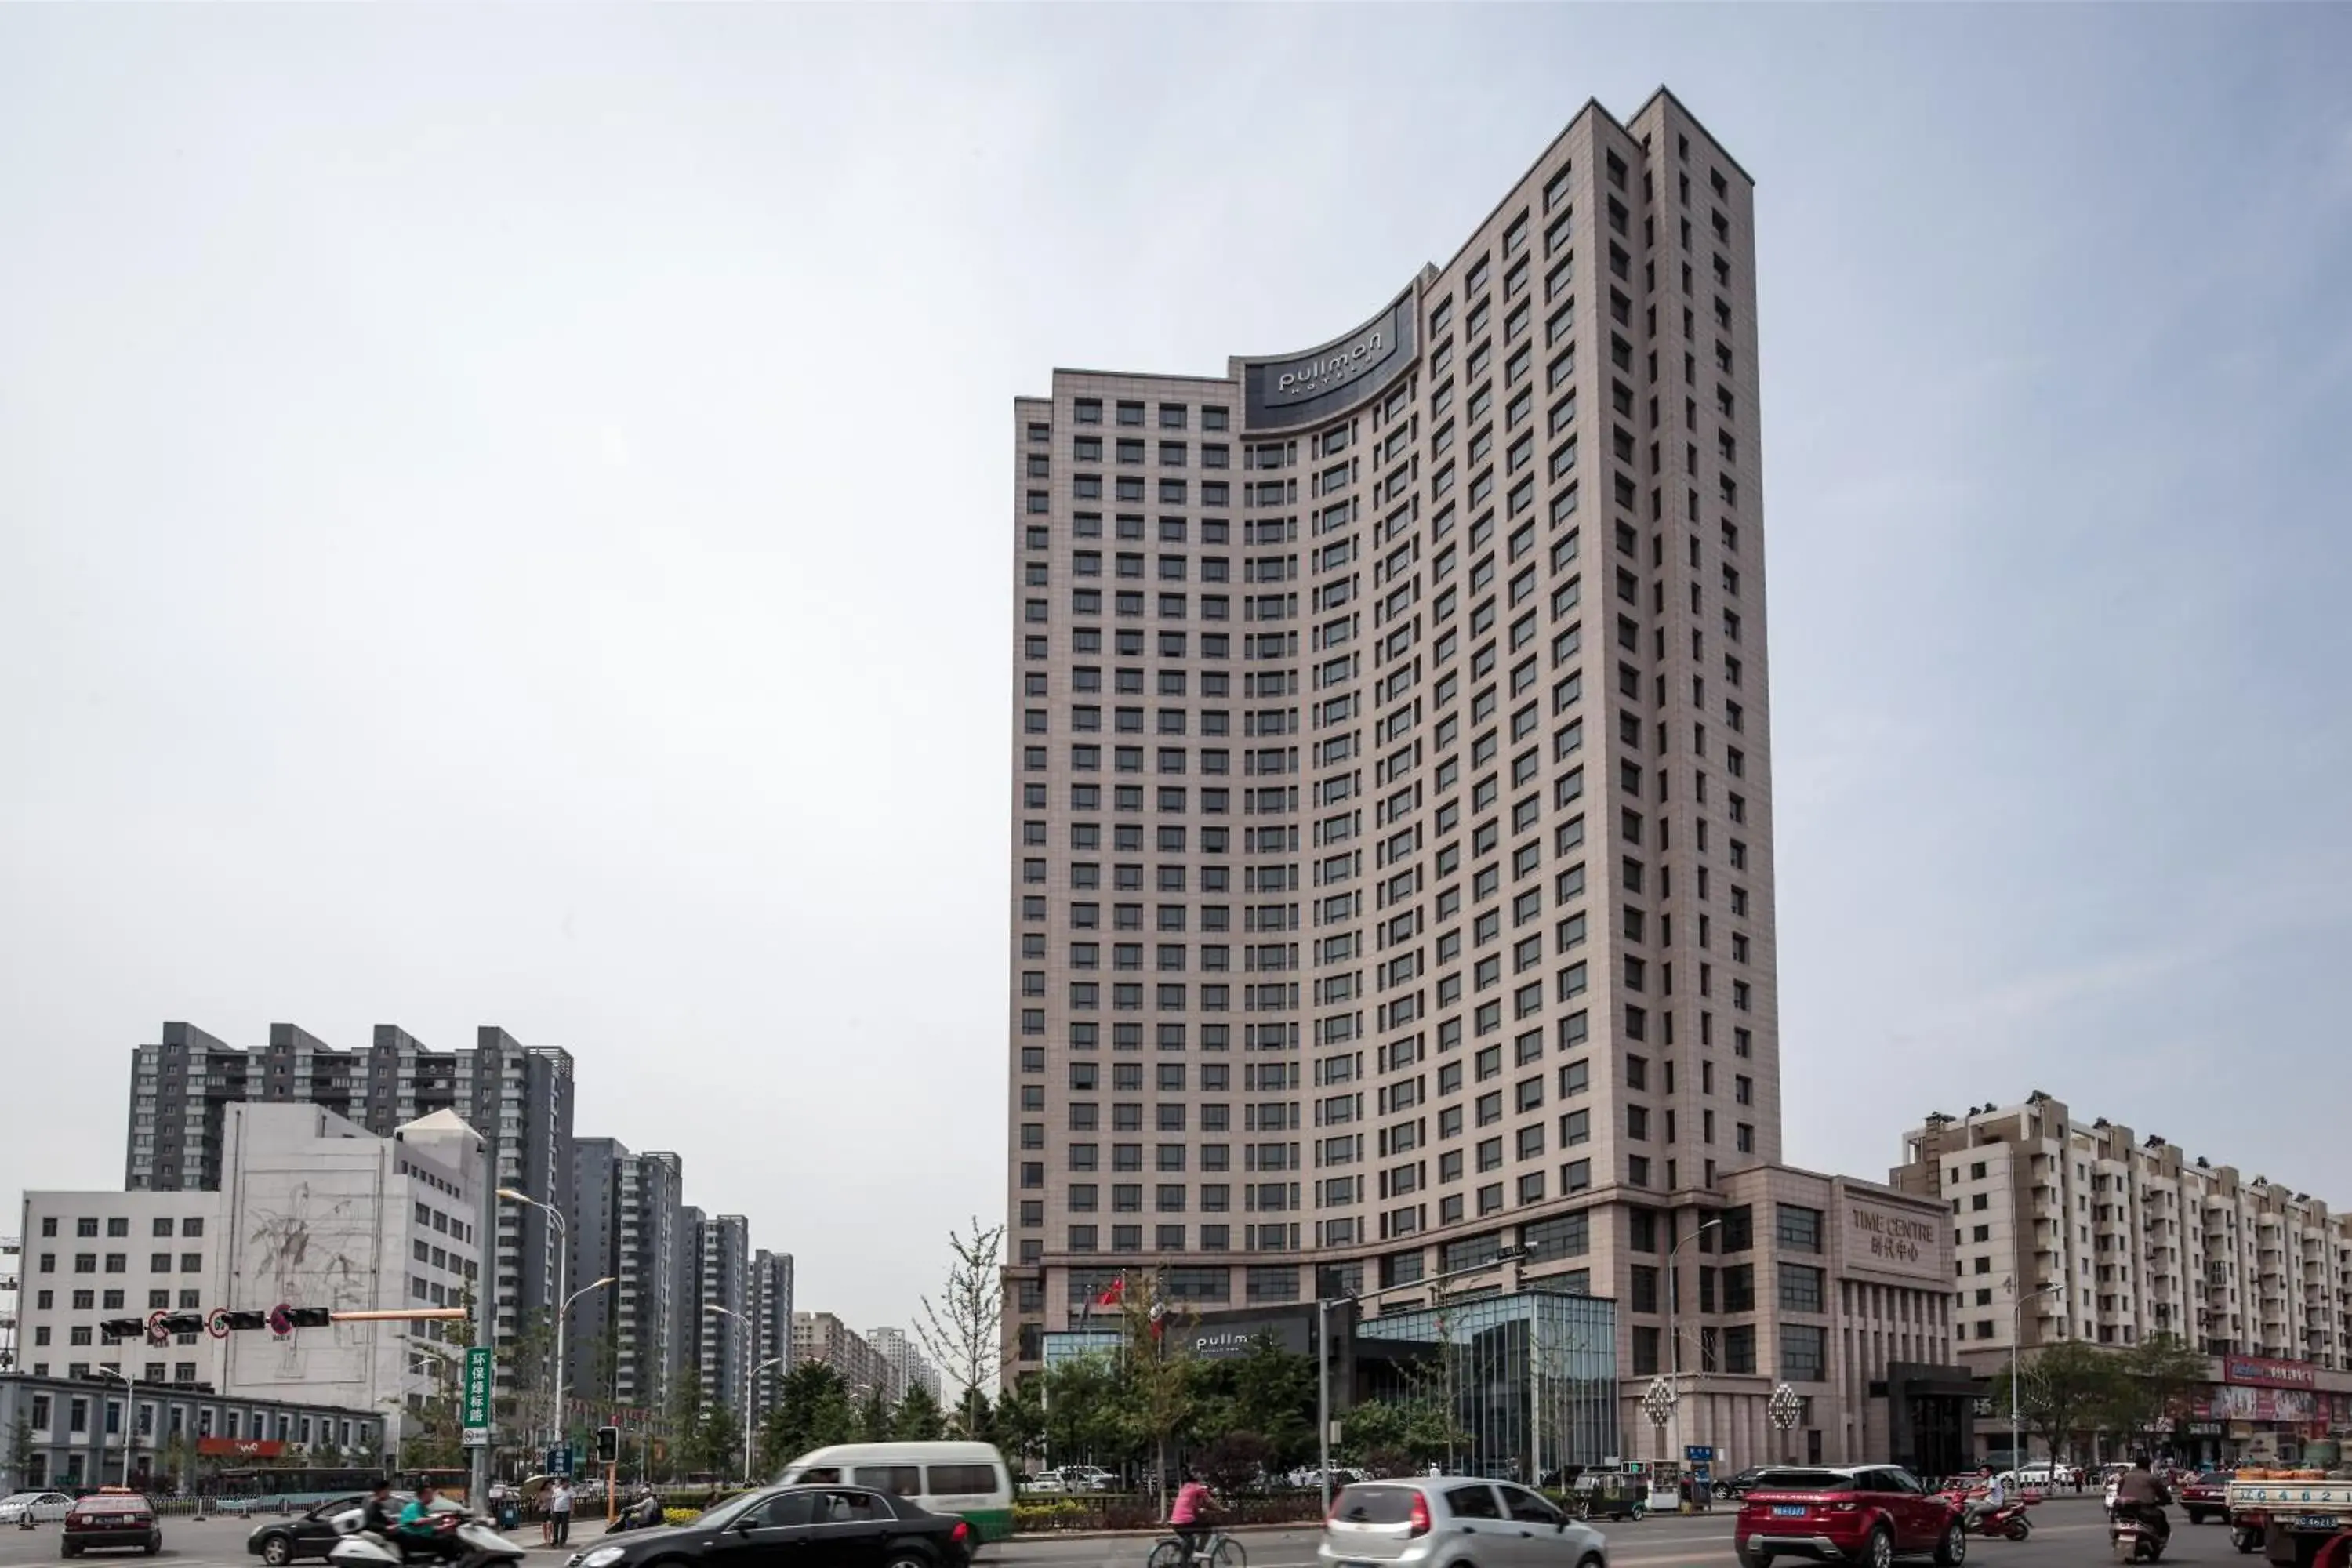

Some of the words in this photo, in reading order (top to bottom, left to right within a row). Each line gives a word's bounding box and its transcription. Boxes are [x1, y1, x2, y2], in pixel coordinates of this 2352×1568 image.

[1853, 1208, 1885, 1234] TIME
[1886, 1216, 1933, 1243] CENTRE
[1871, 1236, 1919, 1262] 时代中心
[470, 1352, 486, 1421] 环保绿标路
